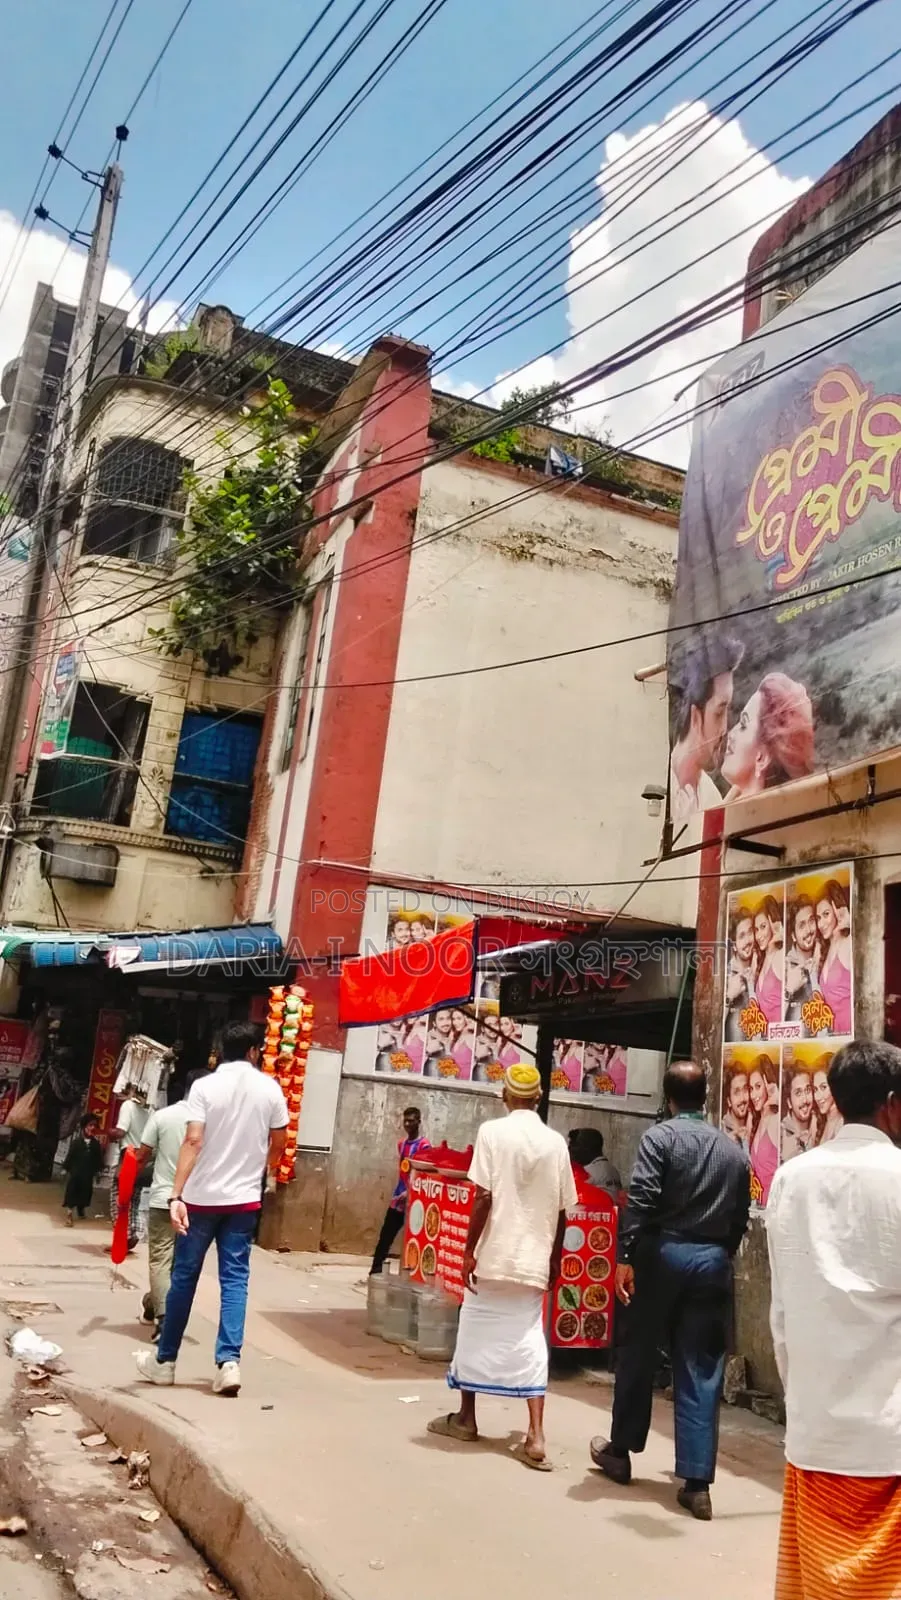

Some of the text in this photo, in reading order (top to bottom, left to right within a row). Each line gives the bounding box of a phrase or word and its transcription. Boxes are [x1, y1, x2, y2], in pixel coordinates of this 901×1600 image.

[856, 540, 894, 569] HOSEN
[412, 1177, 470, 1205] এখানে ভাত
